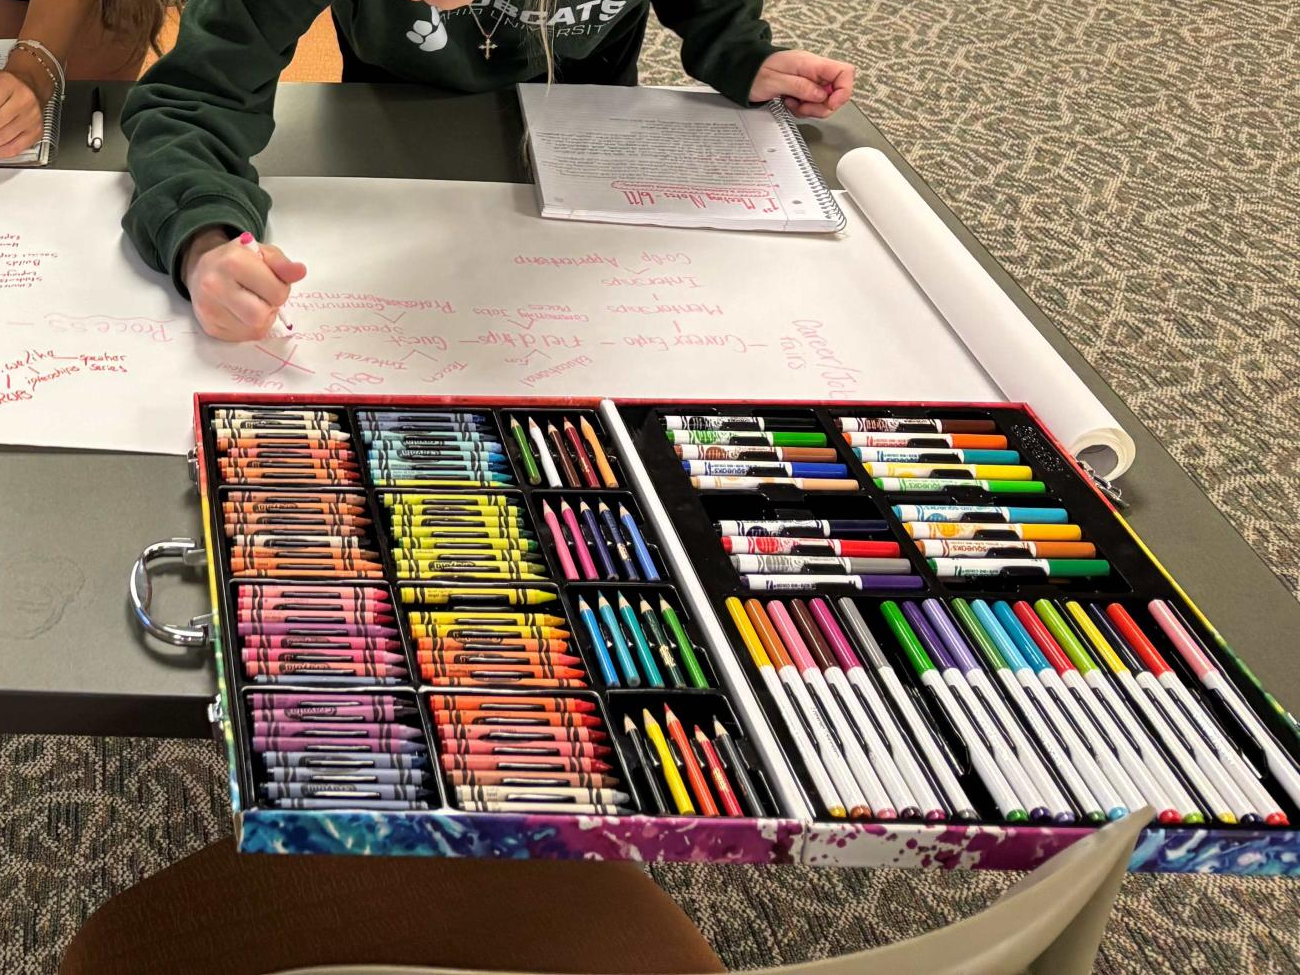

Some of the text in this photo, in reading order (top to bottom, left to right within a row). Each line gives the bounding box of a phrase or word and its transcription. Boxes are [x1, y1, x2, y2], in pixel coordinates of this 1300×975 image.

[663, 193, 707, 210] Notes
[706, 192, 756, 210] Meeting
[48, 319, 175, 343] Process
[385, 335, 448, 352] Guest
[672, 333, 750, 354] Career
